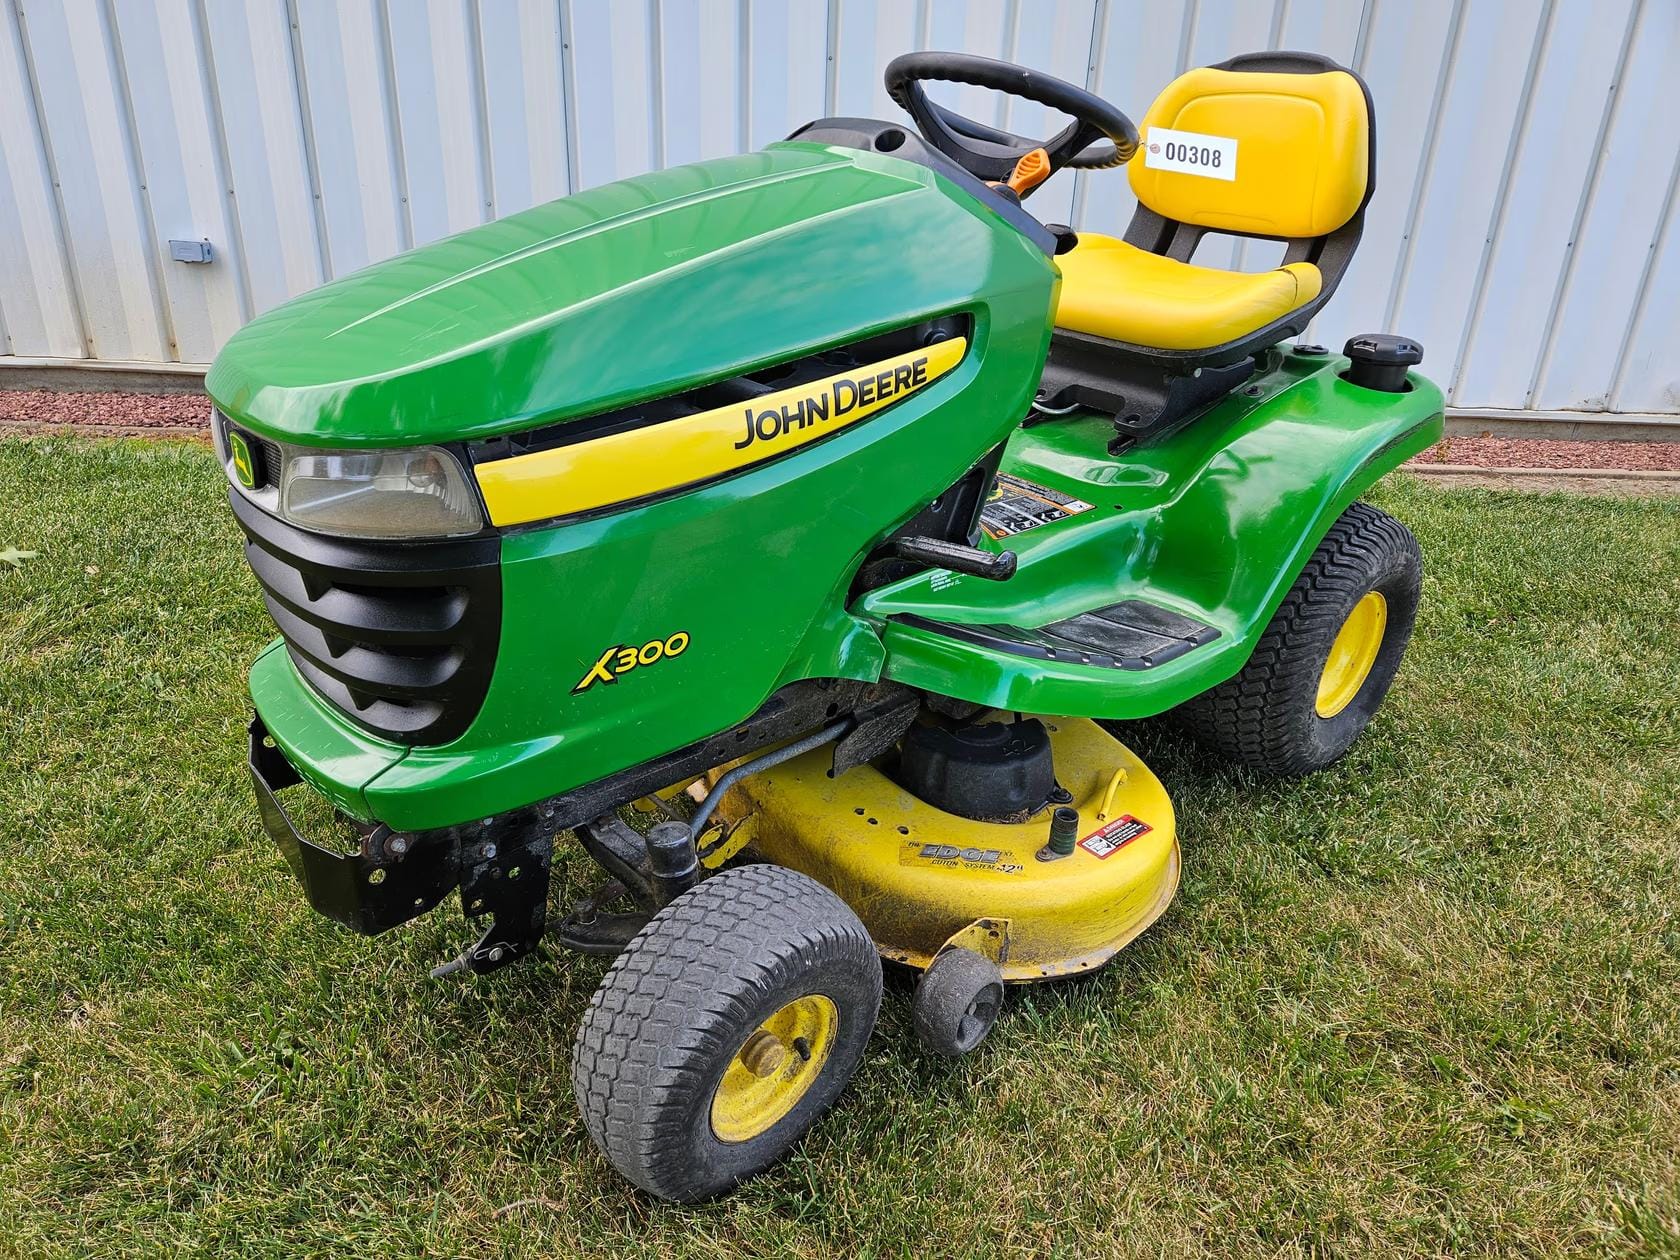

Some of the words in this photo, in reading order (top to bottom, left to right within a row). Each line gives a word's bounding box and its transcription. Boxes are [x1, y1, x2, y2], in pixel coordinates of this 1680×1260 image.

[1166, 142, 1221, 168] 00308
[735, 392, 829, 449] JOHN
[833, 357, 928, 416] DEERE
[570, 631, 691, 695] X300
[918, 844, 1001, 864] EDGE
